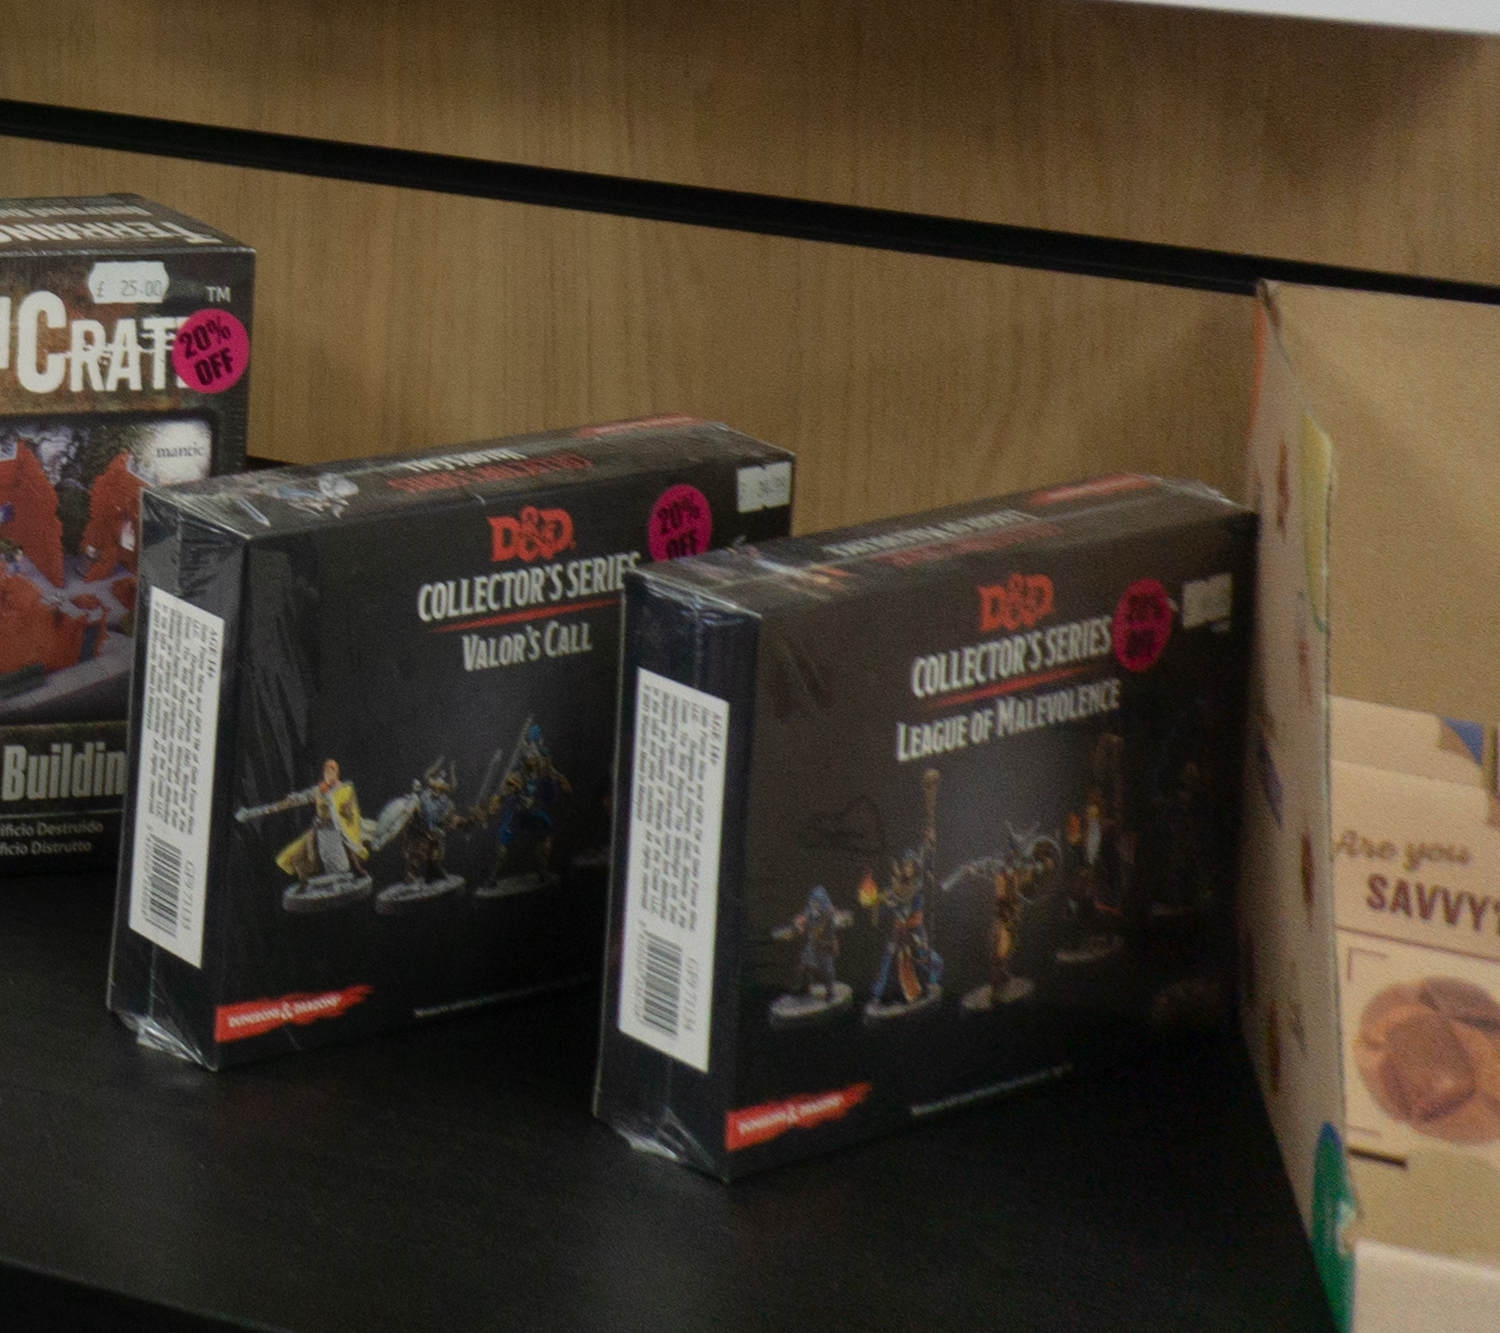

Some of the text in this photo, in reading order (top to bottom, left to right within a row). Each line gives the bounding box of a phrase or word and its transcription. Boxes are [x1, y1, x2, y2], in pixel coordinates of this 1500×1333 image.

[179, 316, 232, 360] 20%
[194, 347, 233, 386] OFF
[486, 504, 576, 563] D&D
[416, 563, 563, 623] COLLECTOR'S
[911, 615, 1114, 699] COLLECTOR'S SERIES
[895, 677, 1122, 763] LEAGUE OF MALEVOLENCE
[2, 740, 128, 801] Buildin
